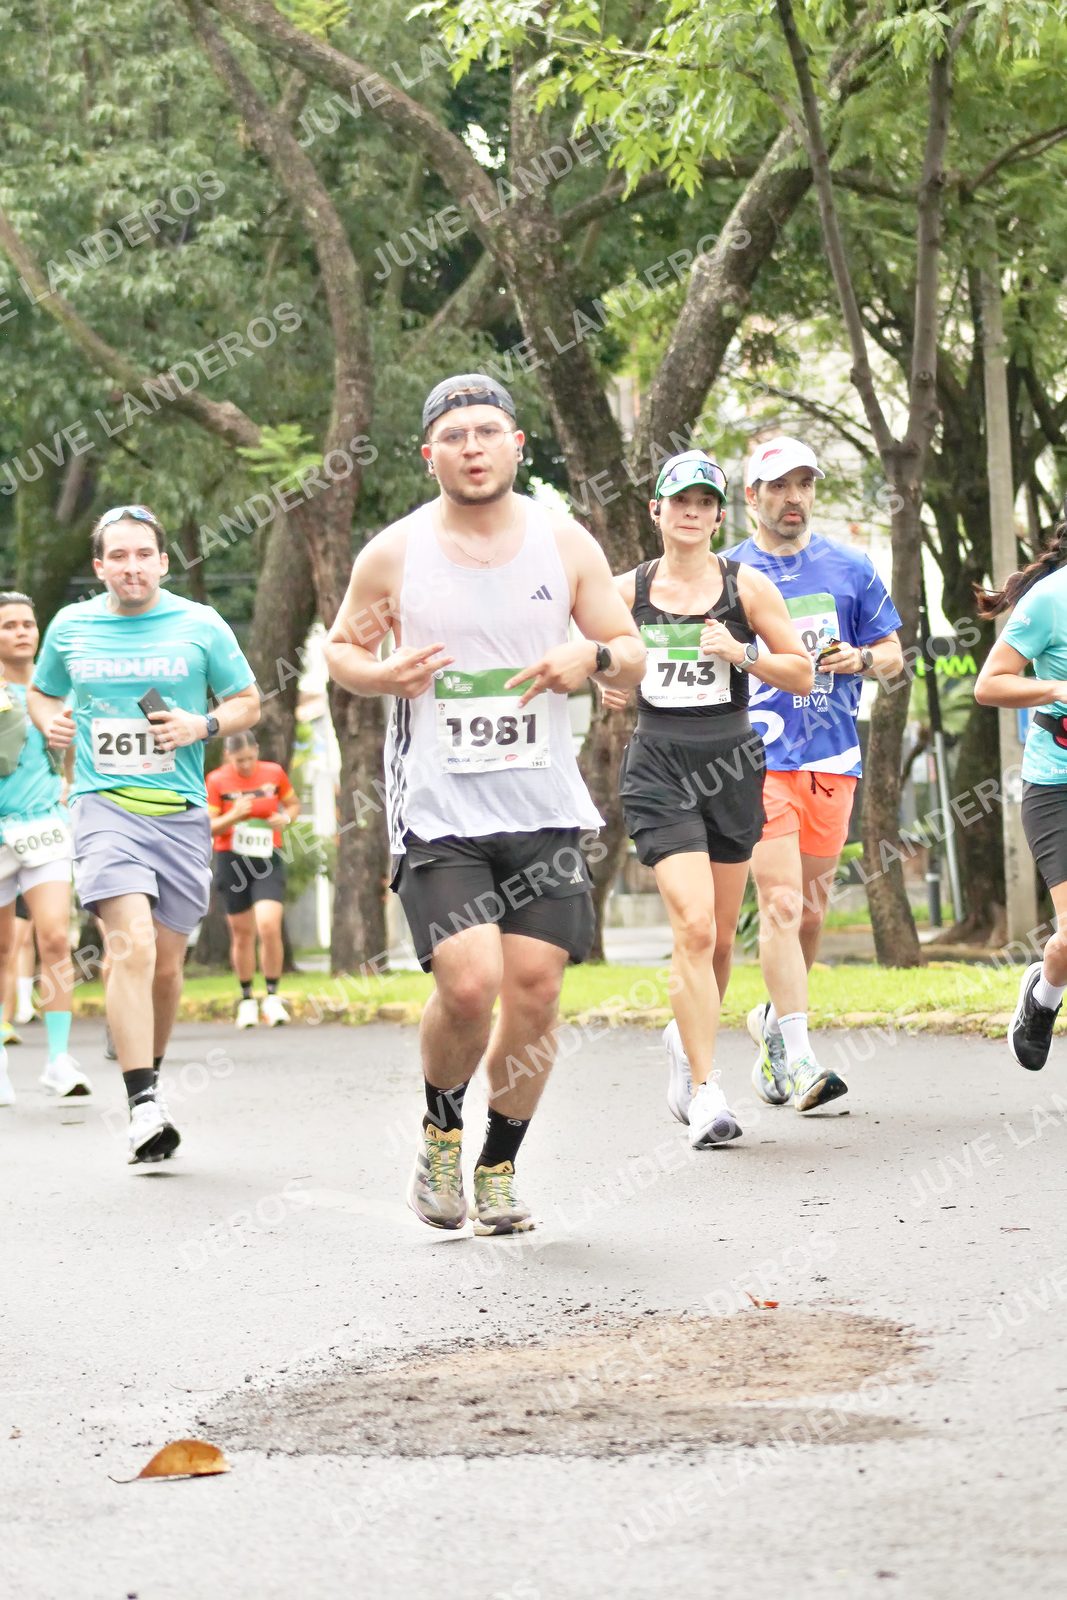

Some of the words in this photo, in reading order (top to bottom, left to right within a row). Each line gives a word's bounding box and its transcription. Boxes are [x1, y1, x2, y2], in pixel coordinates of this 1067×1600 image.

[70, 657, 189, 678] PERDURA
[657, 661, 716, 687] 743
[793, 694, 828, 709] BBVA
[446, 713, 537, 748] 1981
[14, 829, 64, 854] 6068
